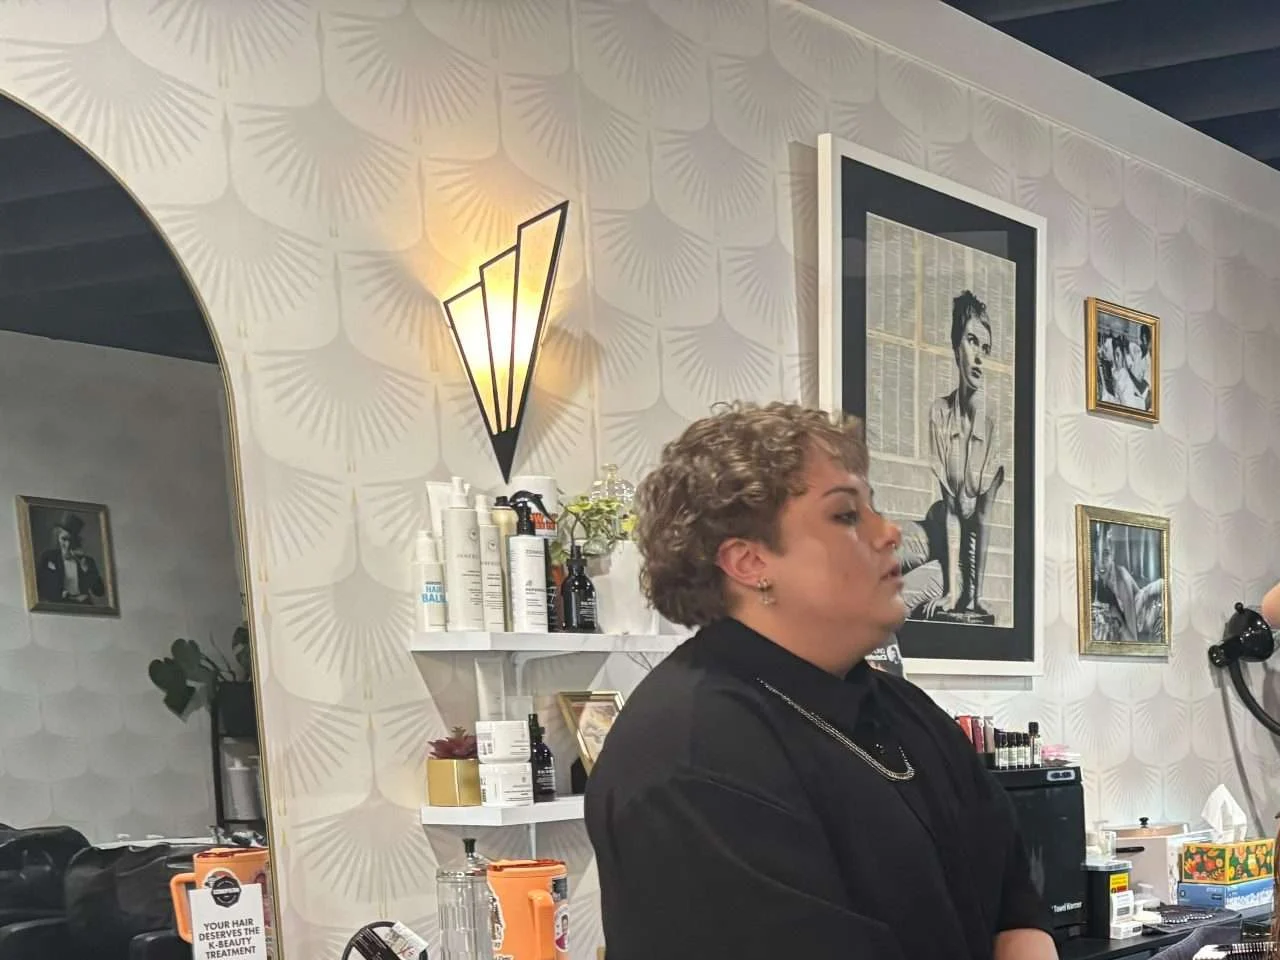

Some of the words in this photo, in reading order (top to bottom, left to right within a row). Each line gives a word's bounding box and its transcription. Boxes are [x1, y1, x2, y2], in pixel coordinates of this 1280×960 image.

[204, 921, 230, 931] YOUR
[232, 919, 253, 928] HAIR
[199, 929, 241, 940] DESERVES
[244, 926, 260, 935] THE
[208, 937, 252, 949] K-BEAUTY
[205, 946, 256, 959] TREATMENT
